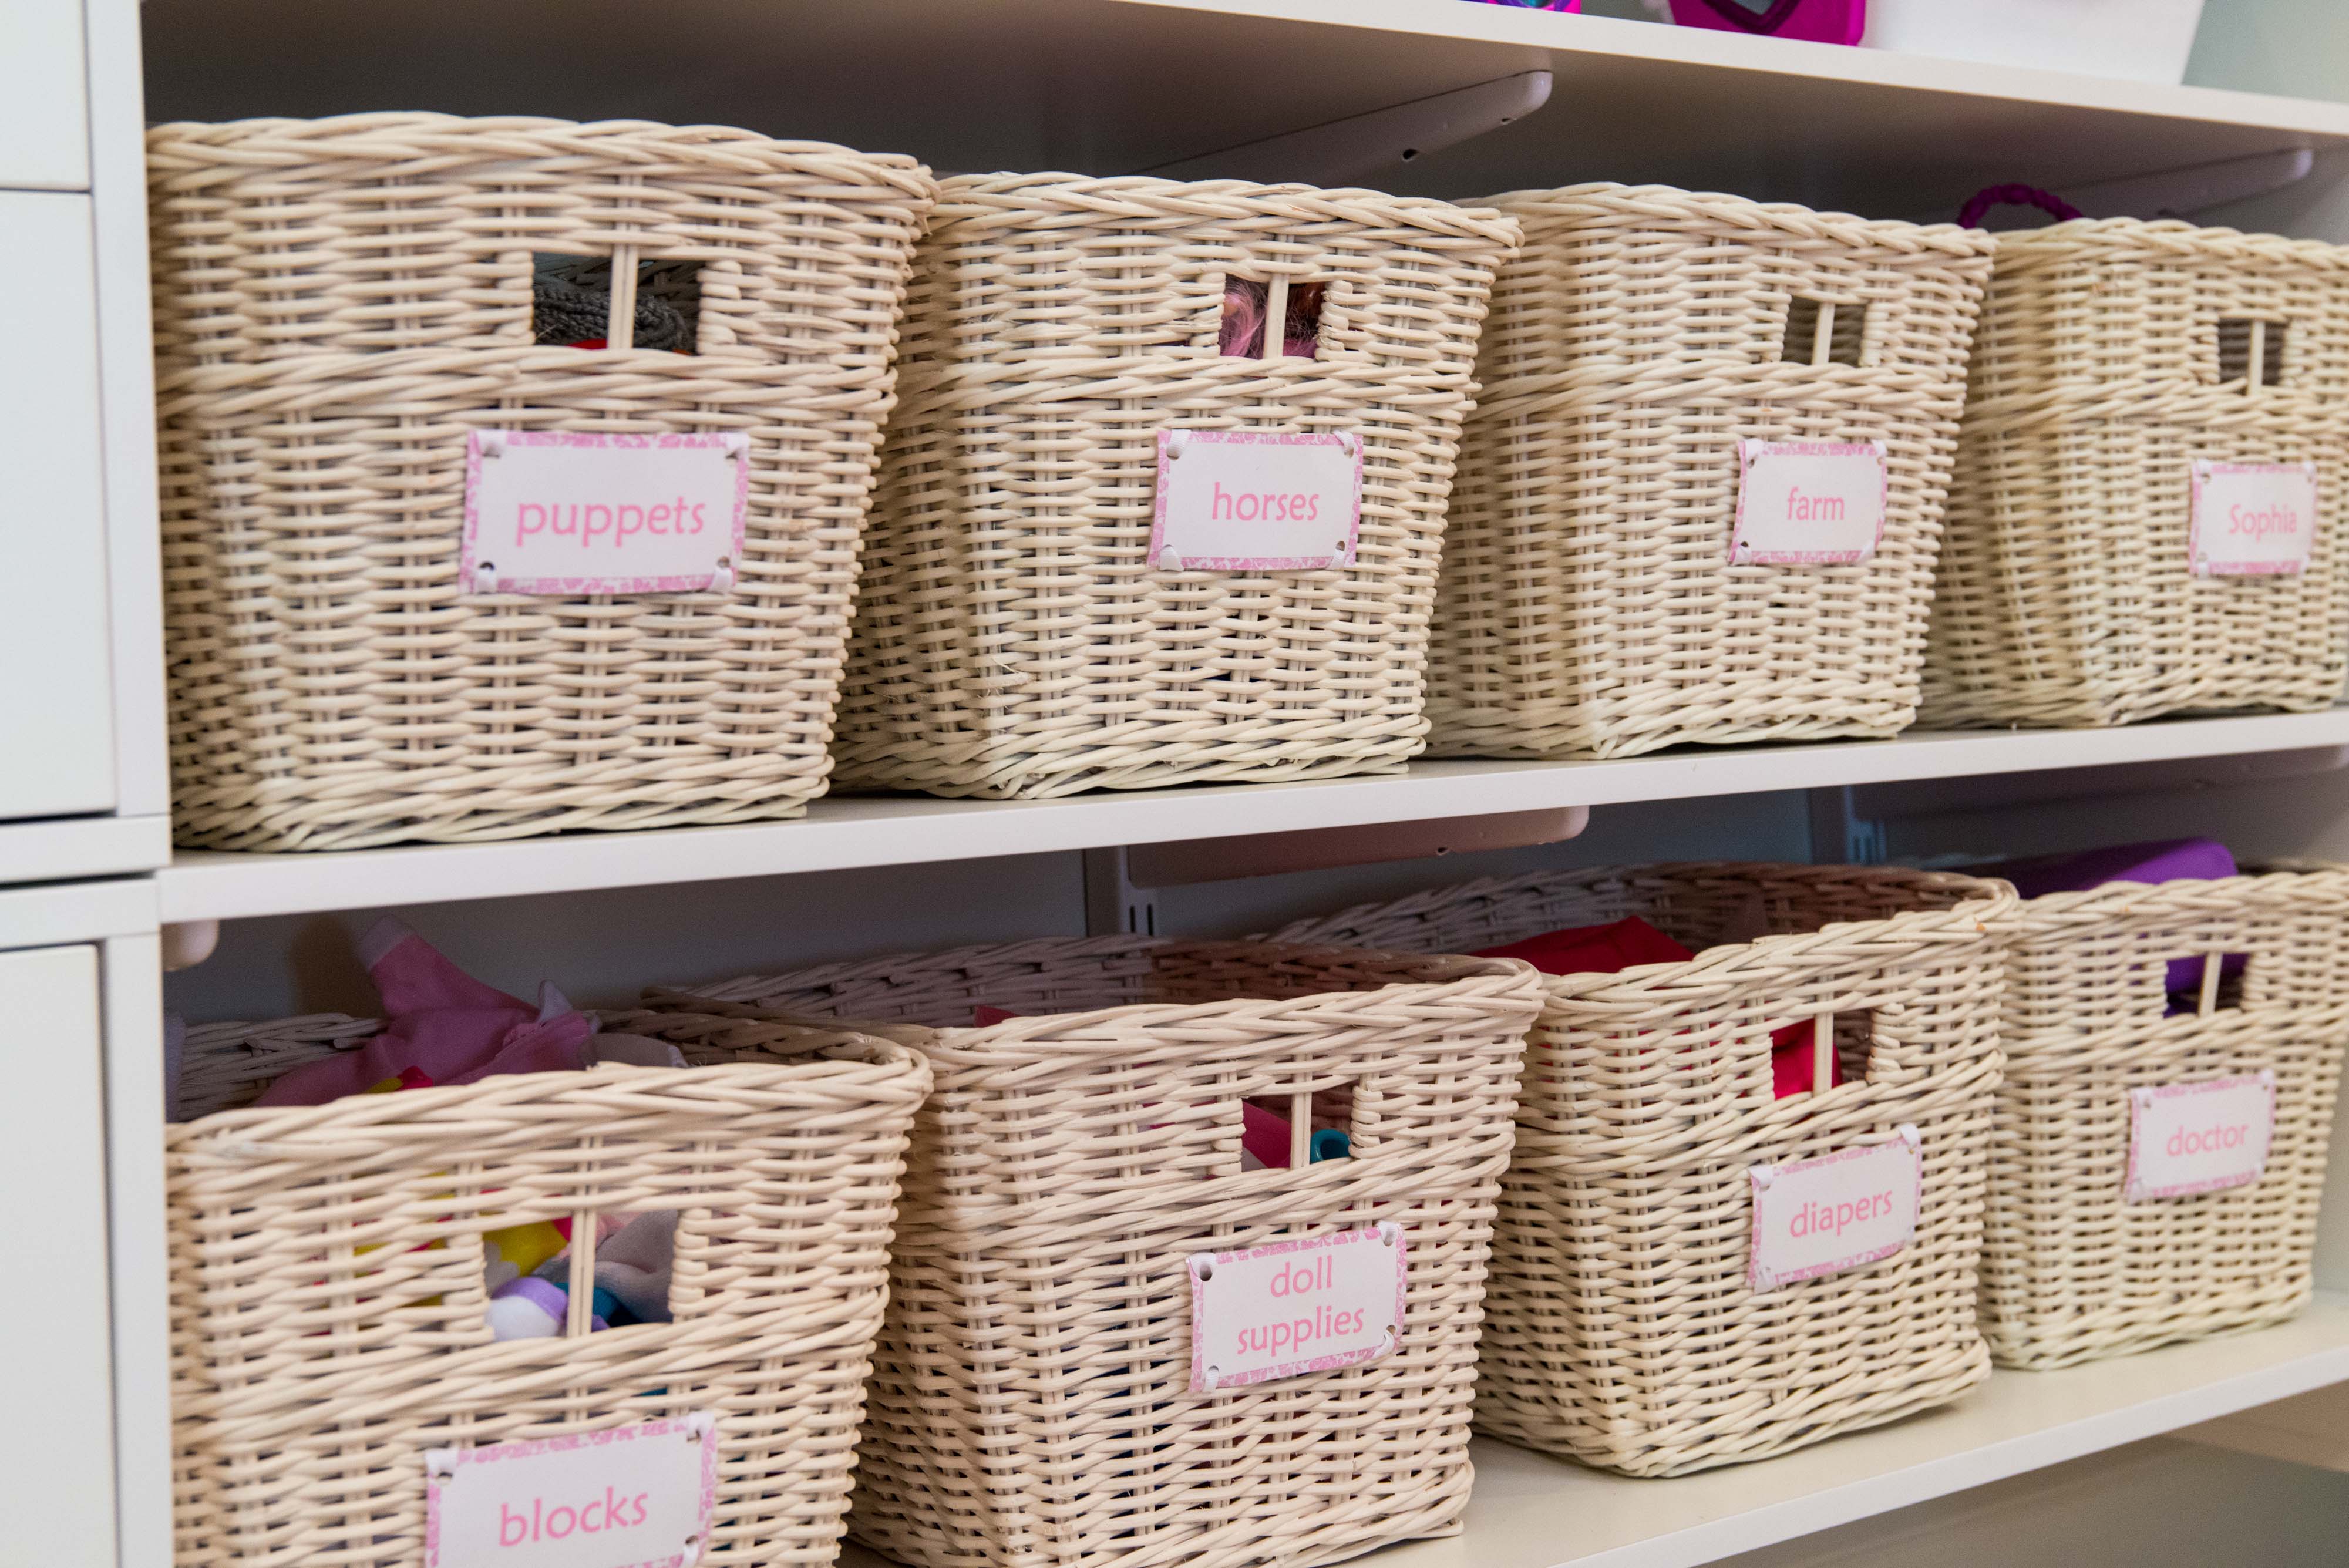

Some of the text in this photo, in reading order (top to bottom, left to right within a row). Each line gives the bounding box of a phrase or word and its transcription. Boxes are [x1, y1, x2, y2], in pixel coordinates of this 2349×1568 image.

[517, 496, 705, 547] puppets
[1212, 481, 1320, 521] horses
[1787, 486, 1845, 521] farm
[2229, 504, 2297, 542] Sophia
[2167, 1123, 2249, 1157] doctor
[1790, 1188, 1893, 1237] diapers
[1270, 1255, 1332, 1298] doll
[1237, 1307, 1365, 1358] supplies
[500, 1485, 648, 1547] blocks
